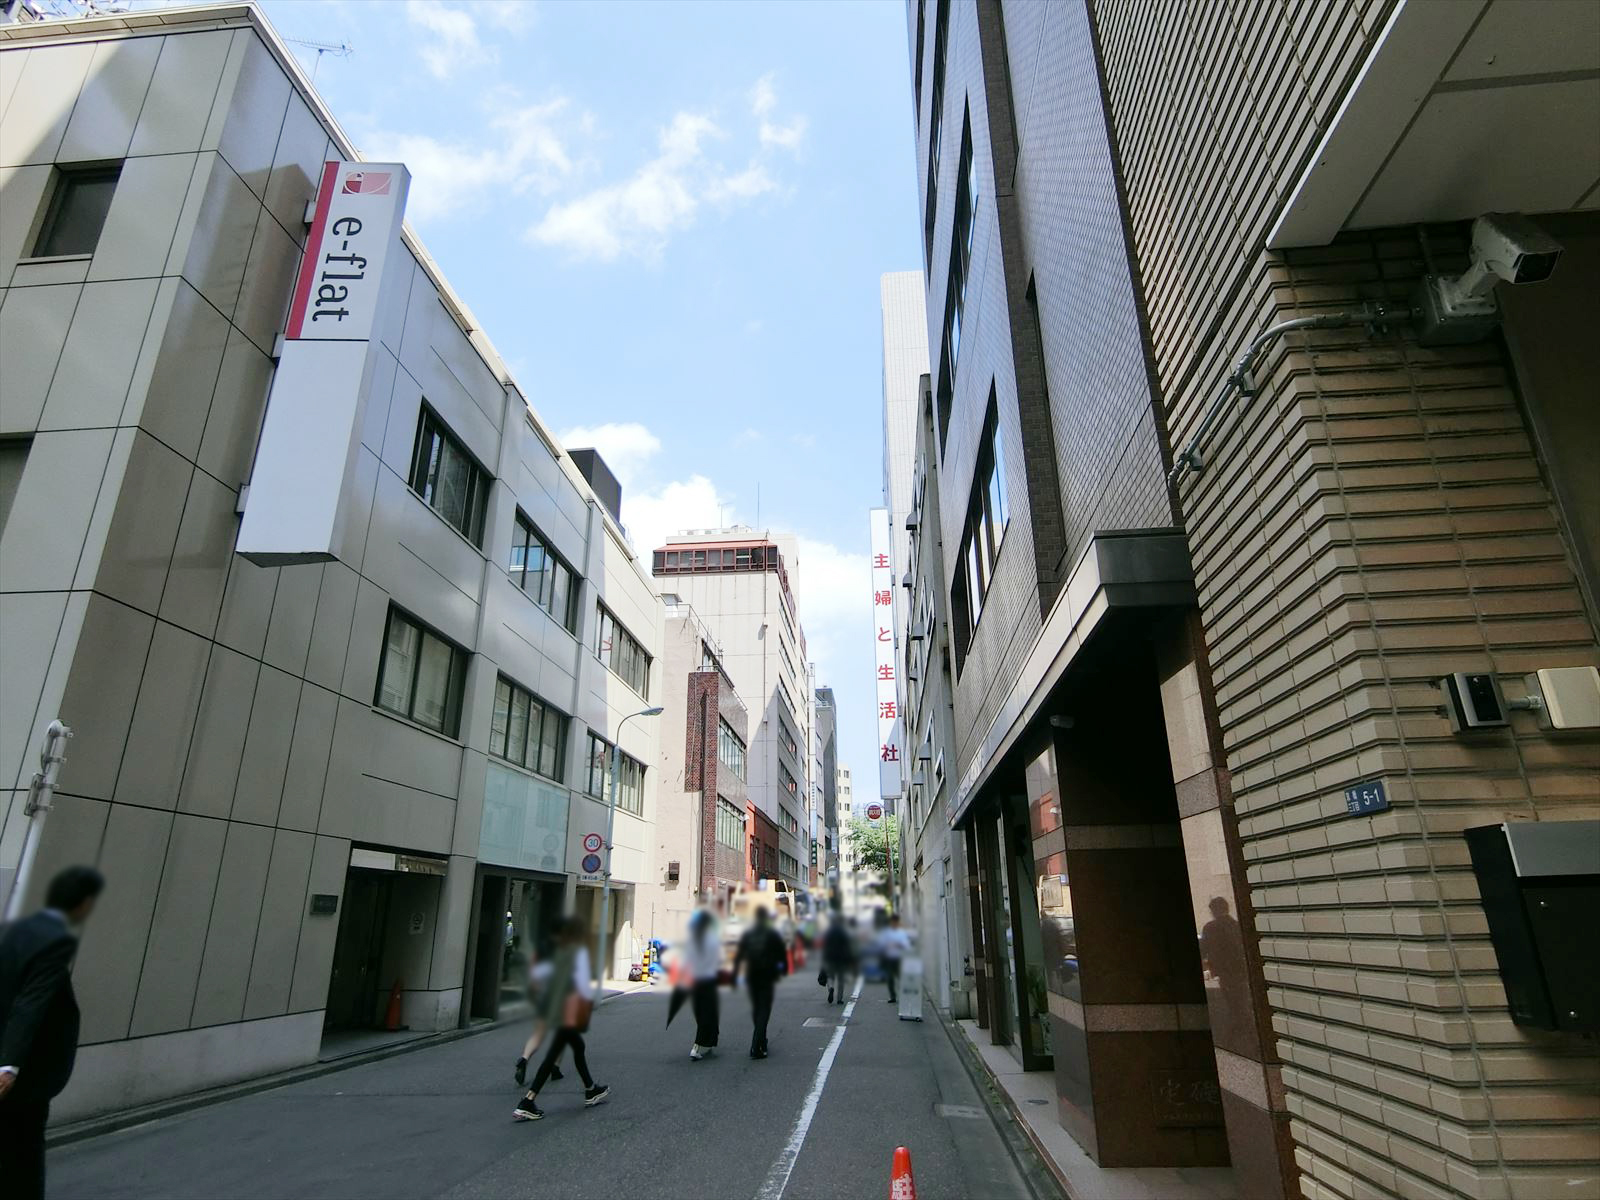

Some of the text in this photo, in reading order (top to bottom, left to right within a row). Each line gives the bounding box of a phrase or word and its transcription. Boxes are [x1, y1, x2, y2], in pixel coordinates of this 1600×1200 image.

[312, 217, 367, 321] e-flat
[873, 553, 900, 763] 主婦と生活社
[1363, 788, 1380, 805] 5-1
[587, 838, 599, 848] 30
